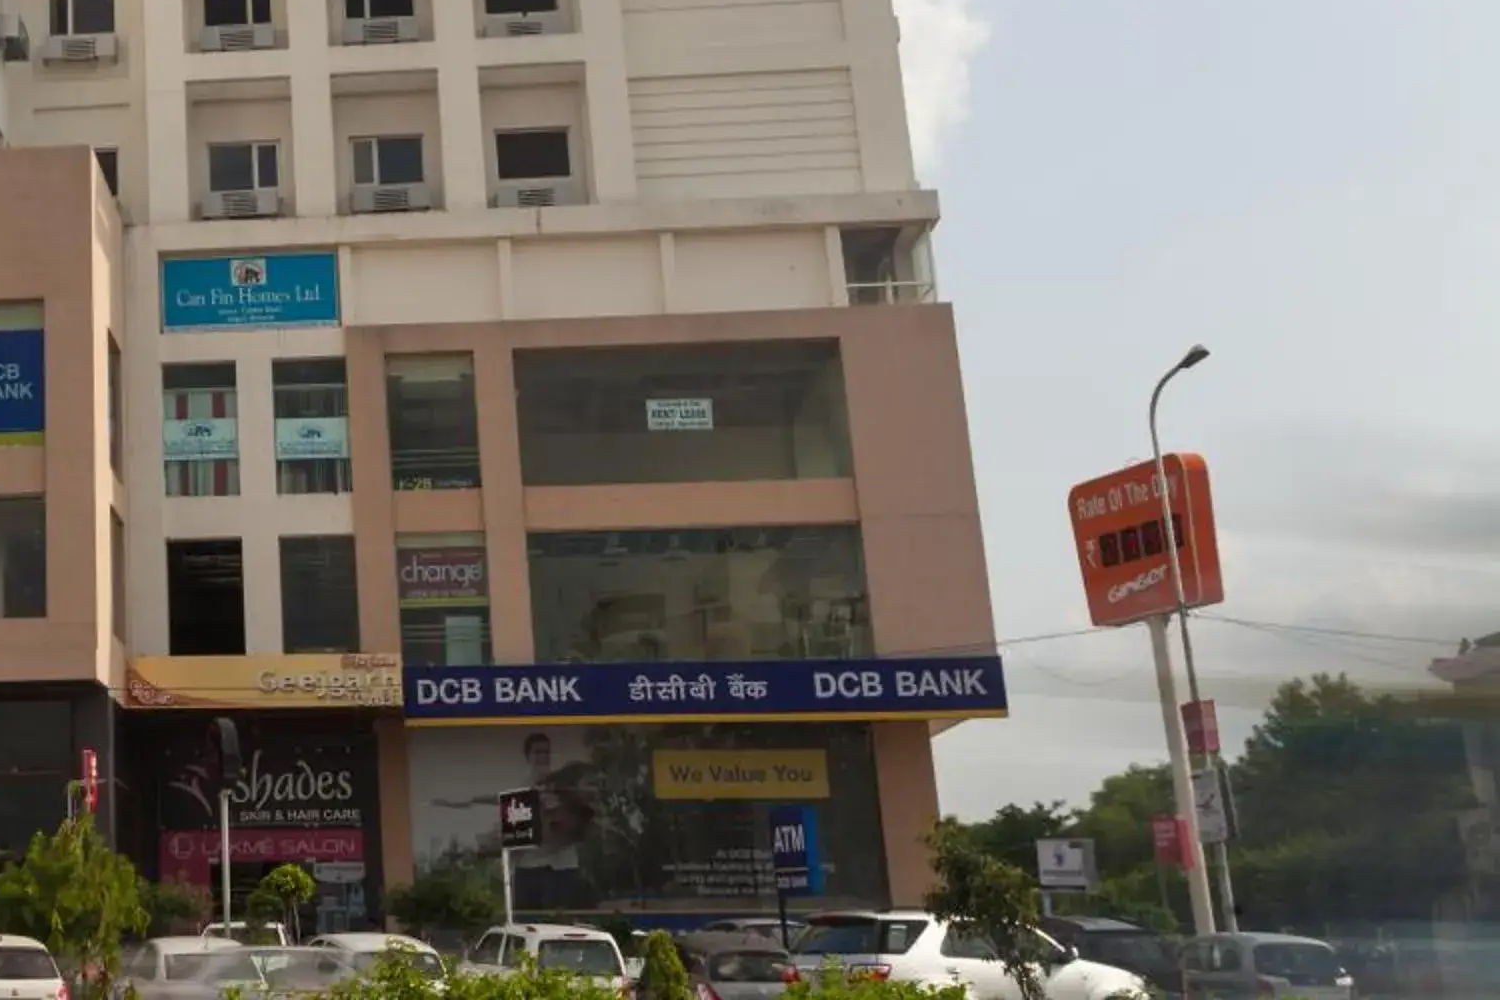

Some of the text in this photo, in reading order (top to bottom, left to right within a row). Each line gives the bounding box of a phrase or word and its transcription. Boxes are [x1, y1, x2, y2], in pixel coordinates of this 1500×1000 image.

[176, 289, 206, 307] Can
[210, 287, 234, 305] Fin
[238, 286, 291, 304] Homes
[1076, 472, 1179, 521] Rate Of The Dy
[417, 677, 582, 705] DCB BANK
[627, 672, 769, 701] डीसीबी बैंक
[813, 668, 988, 698] DCB BANK
[669, 762, 812, 784] We Value You
[240, 808, 361, 822] SKIN & HAIR CARE
[773, 824, 805, 853] ATM
